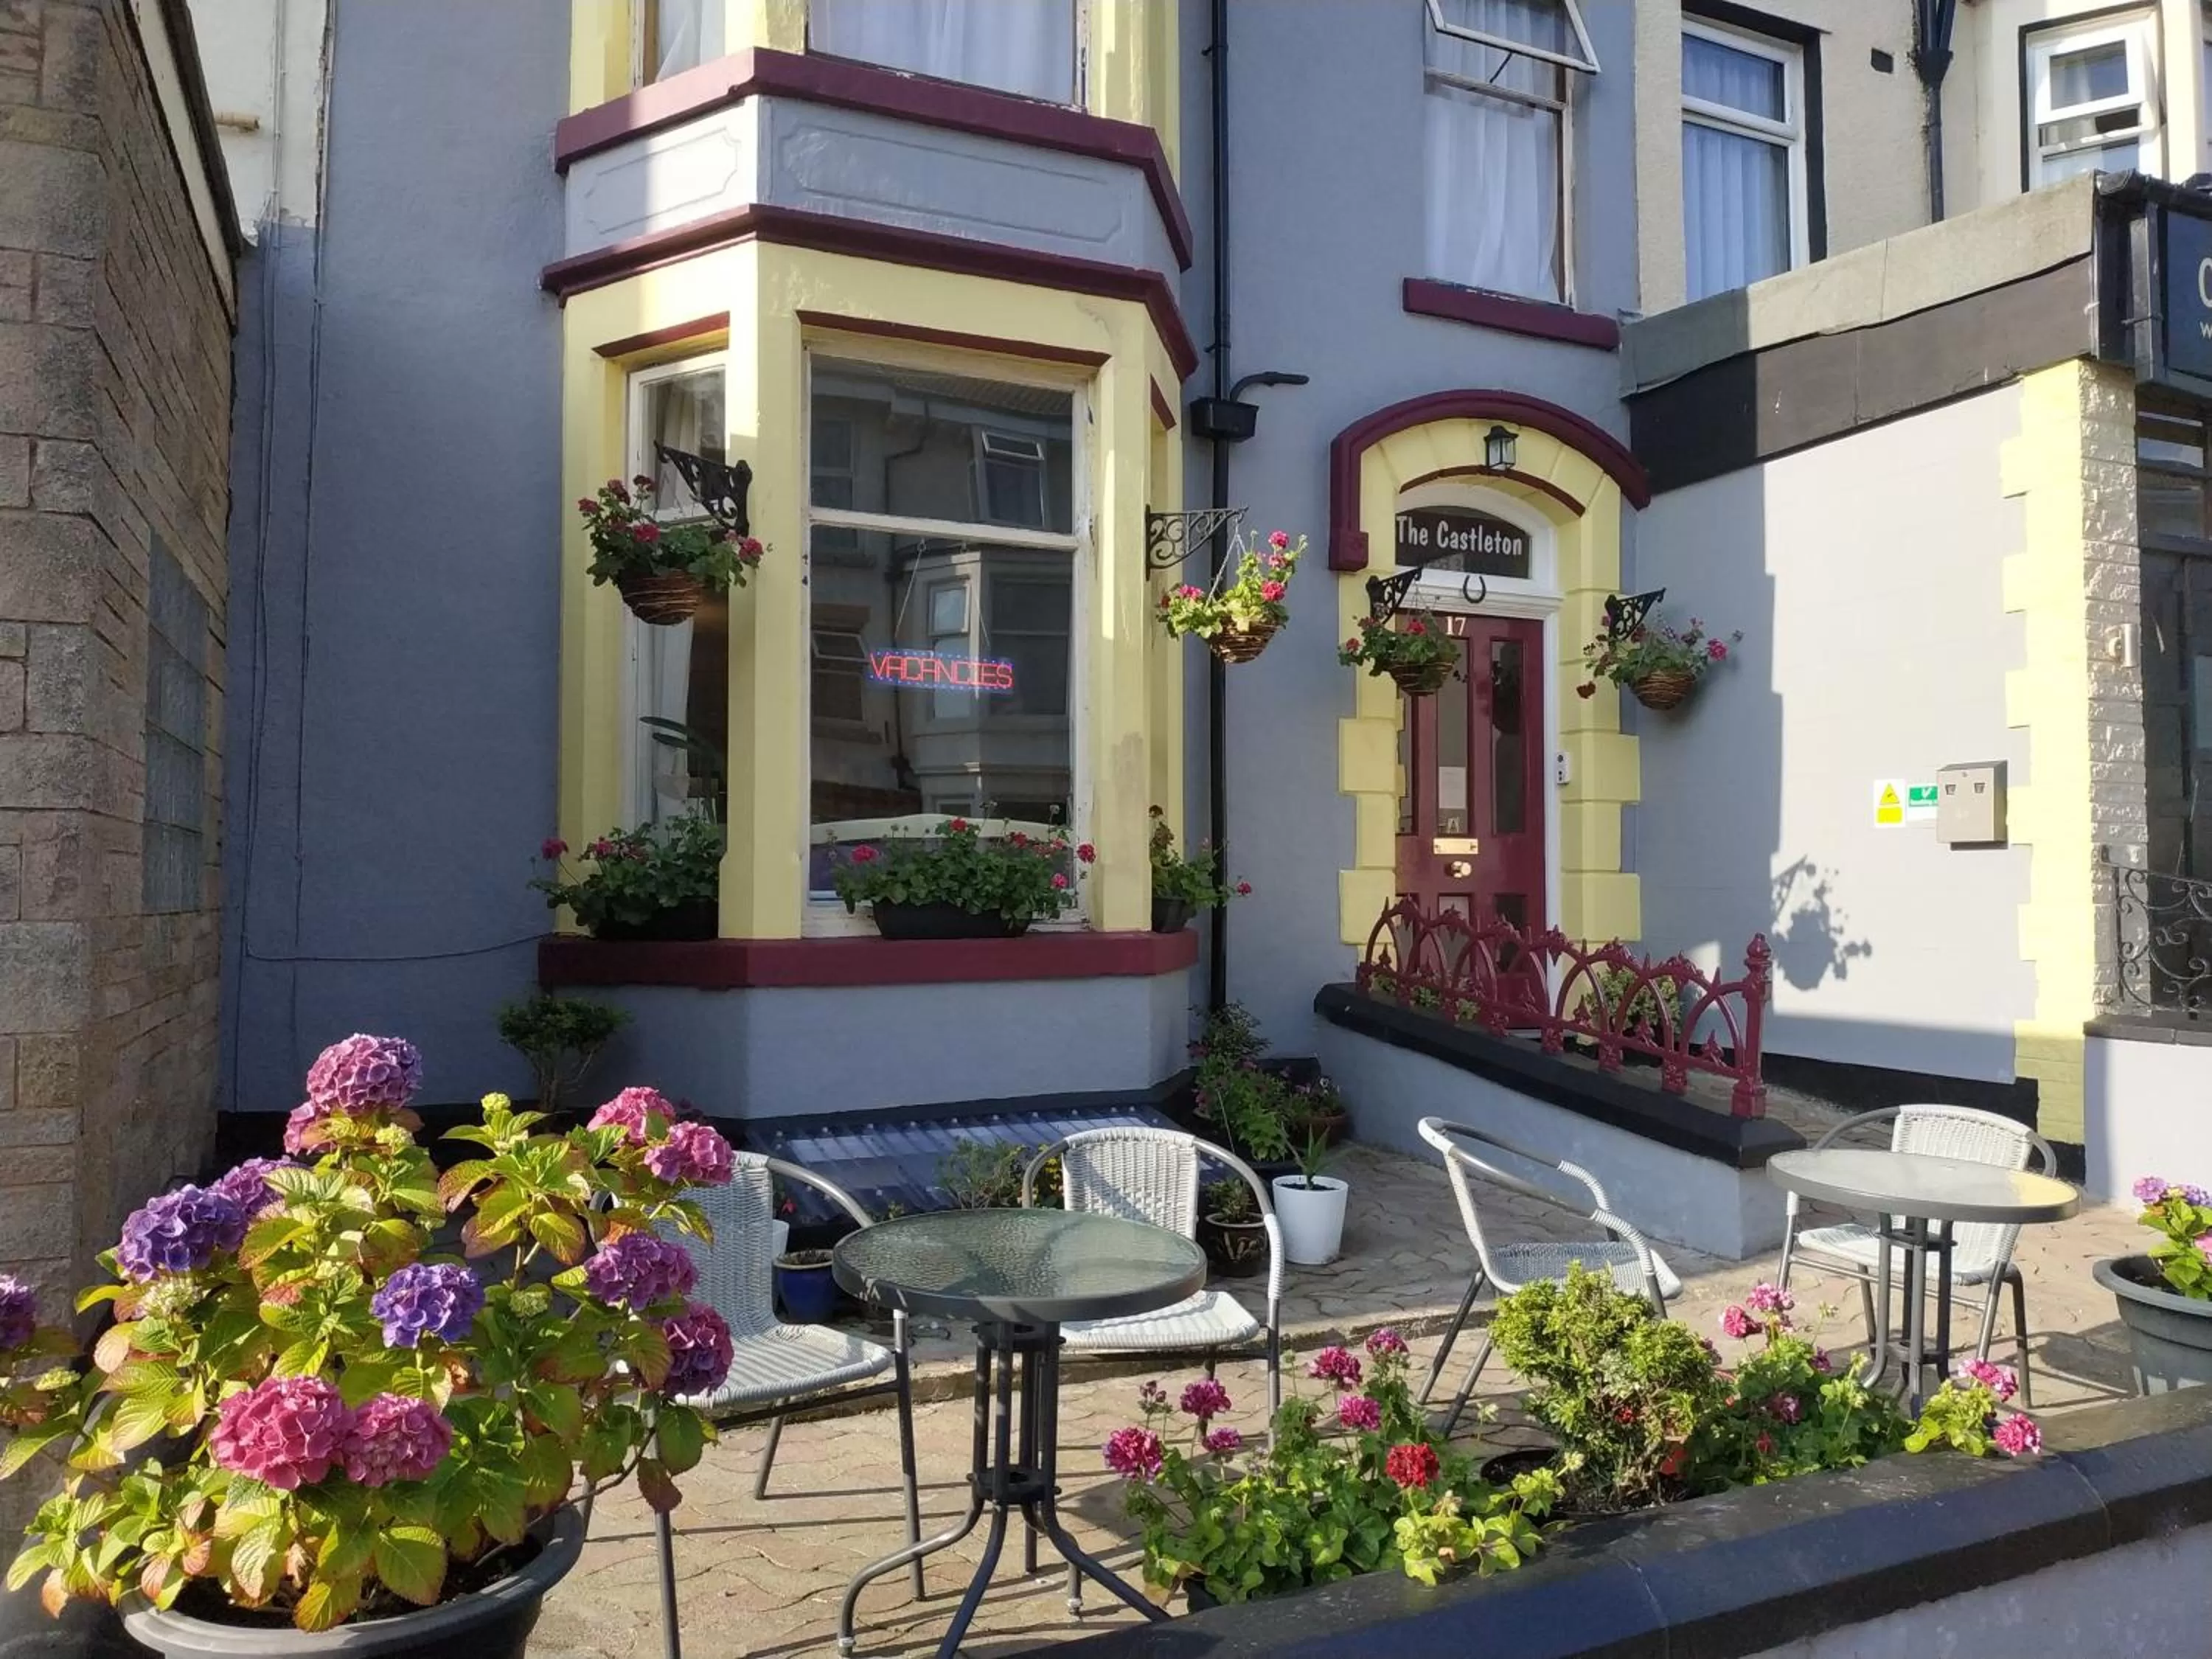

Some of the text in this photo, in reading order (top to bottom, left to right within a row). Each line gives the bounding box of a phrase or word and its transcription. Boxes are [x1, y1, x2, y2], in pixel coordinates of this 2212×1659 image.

[1396, 515, 1522, 555] The Castleton
[1446, 616, 1467, 636] 17
[870, 650, 1015, 688] VACANCIES
